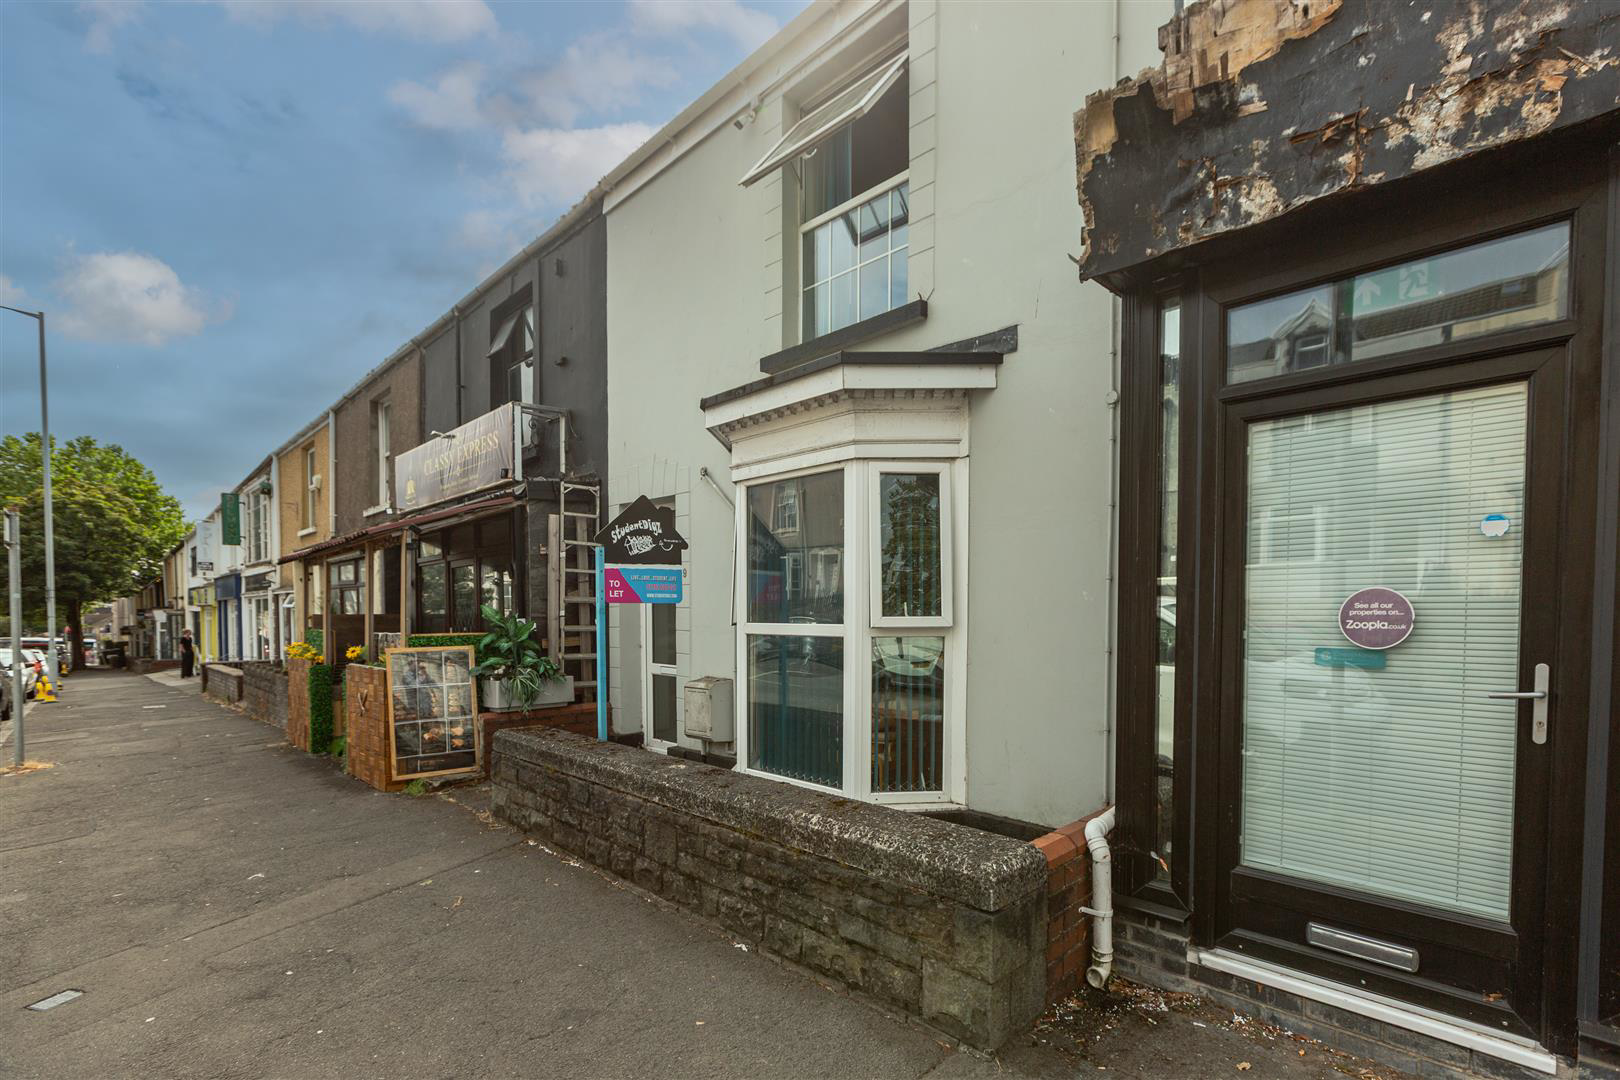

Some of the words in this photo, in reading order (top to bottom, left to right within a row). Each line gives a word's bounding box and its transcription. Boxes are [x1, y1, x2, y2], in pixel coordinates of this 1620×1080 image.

[457, 431, 499, 464] EXPRESS
[611, 519, 662, 544] StudentDigz
[609, 590, 624, 598] LET
[1346, 620, 1407, 631] Zoopla.co.uk
